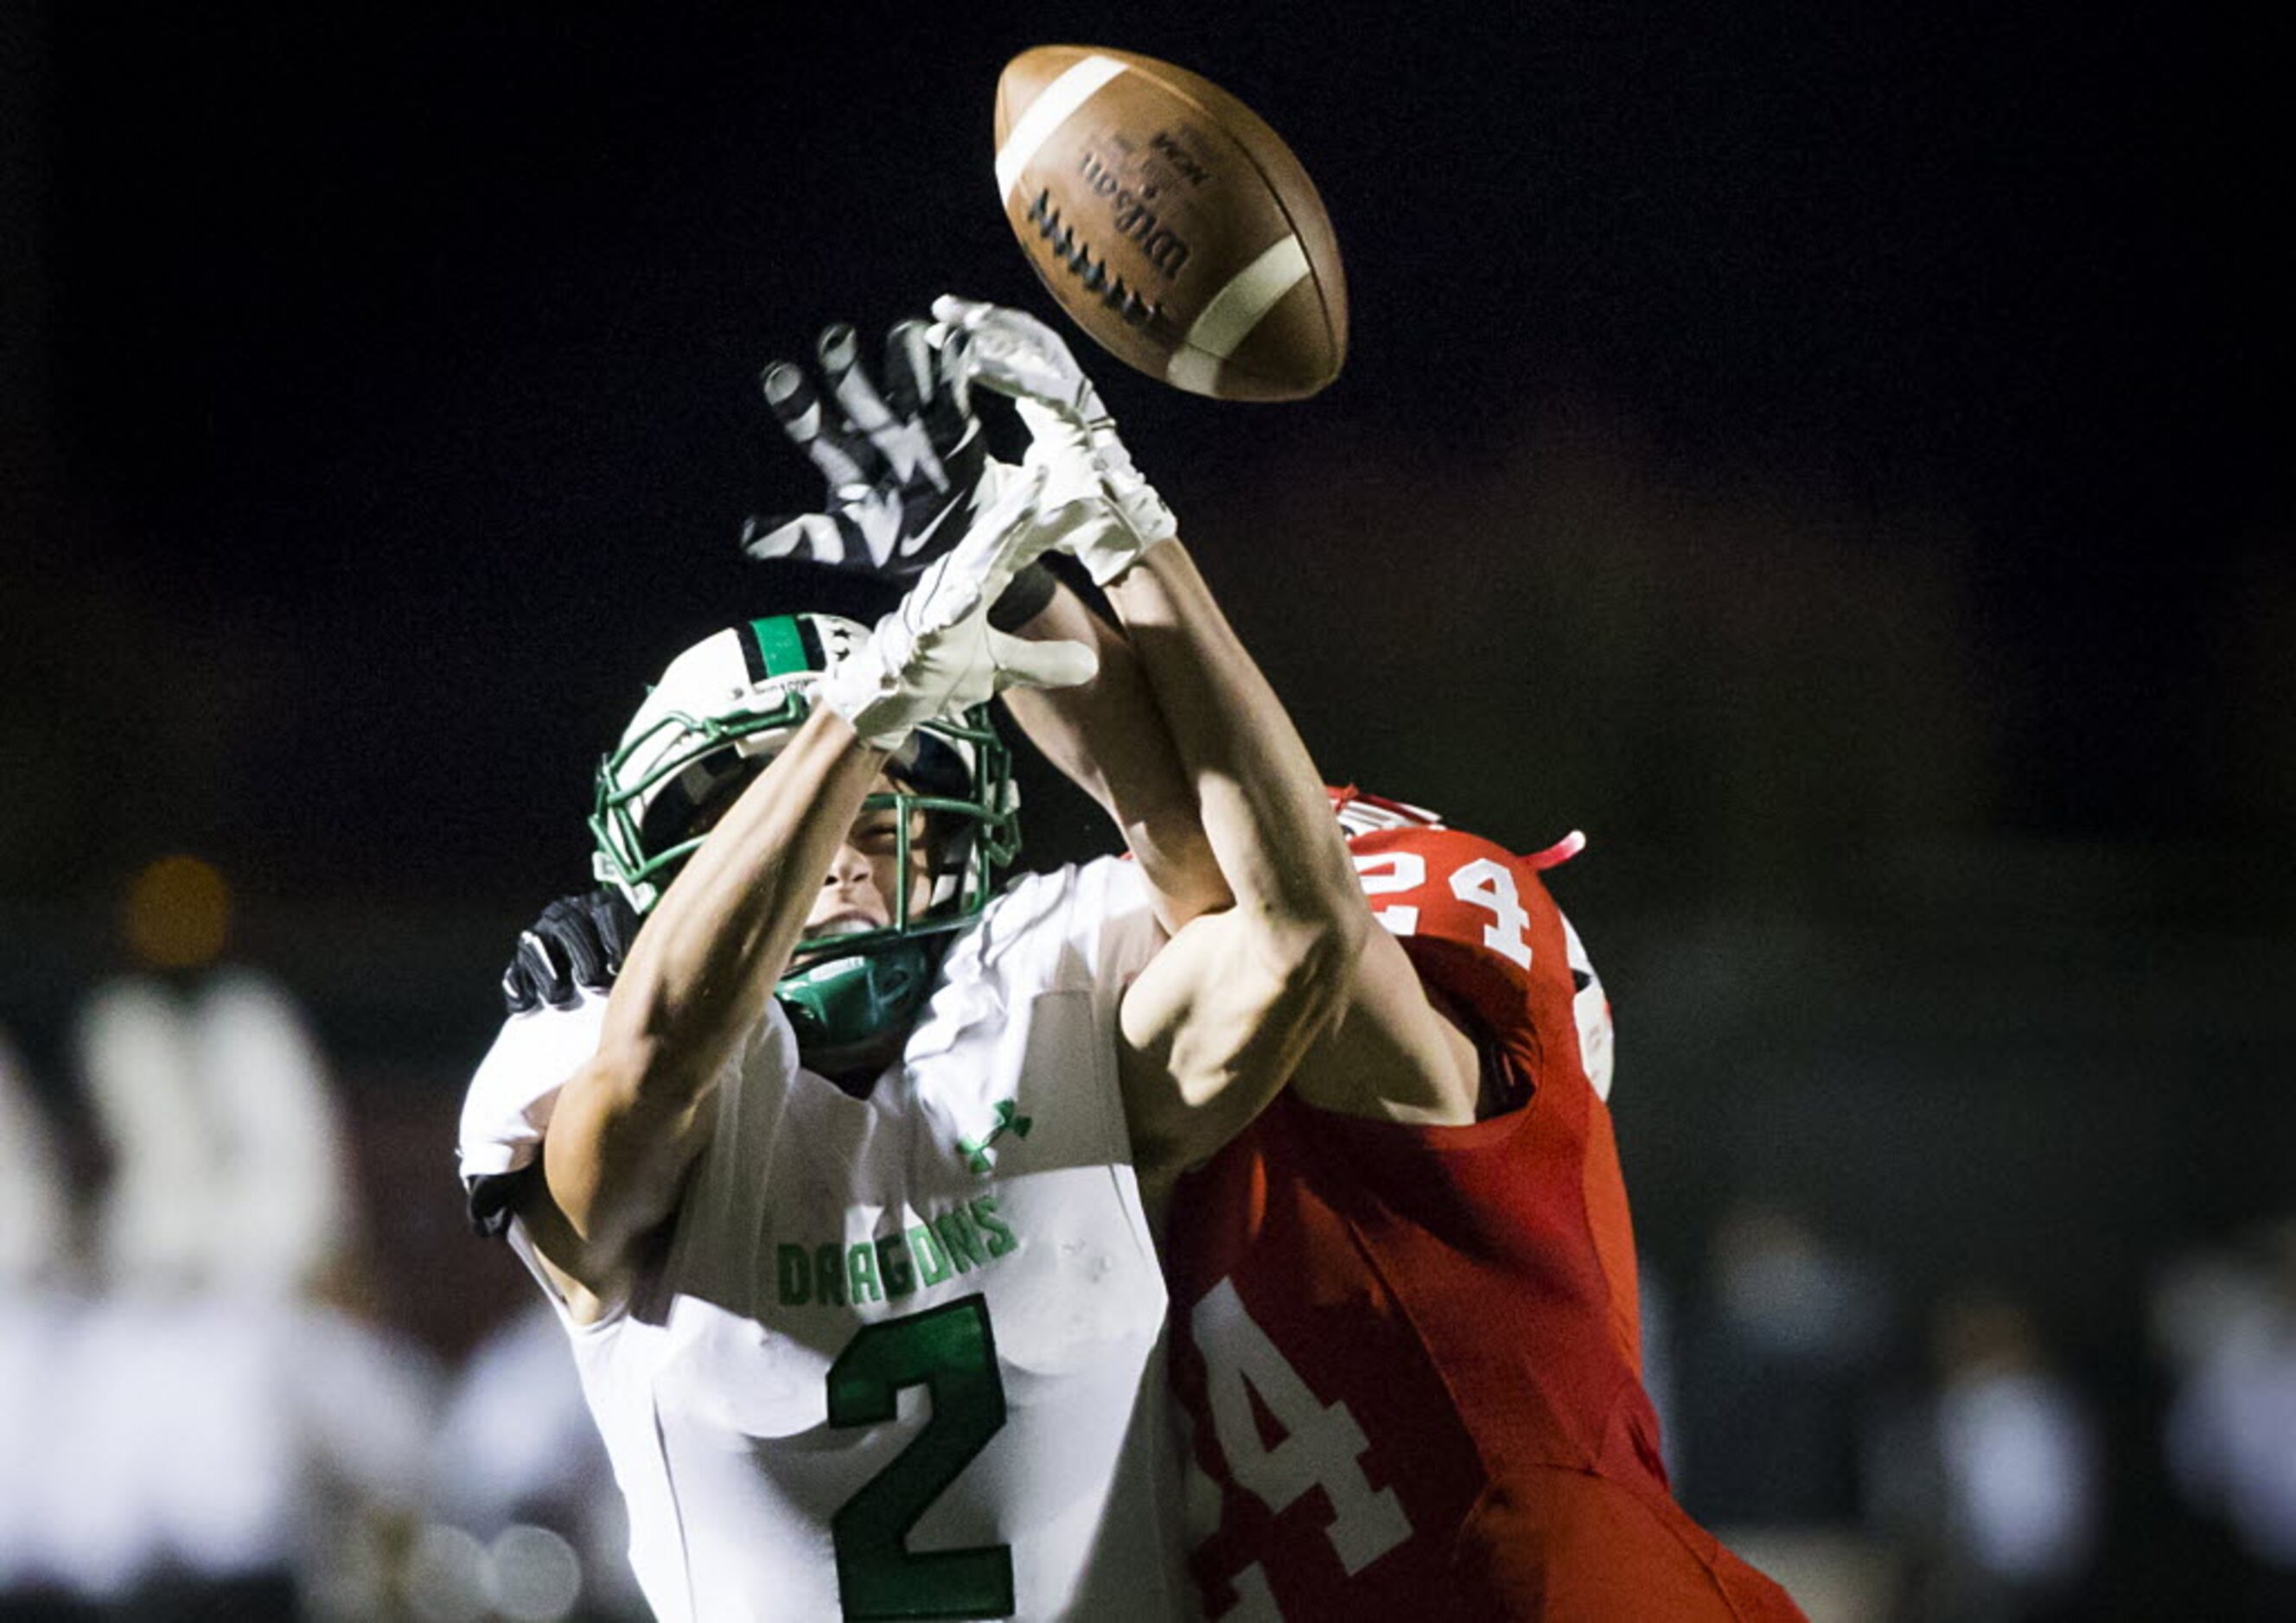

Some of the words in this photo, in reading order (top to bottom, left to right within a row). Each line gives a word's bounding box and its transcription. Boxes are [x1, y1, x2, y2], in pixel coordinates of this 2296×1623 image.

[1351, 851, 1533, 971] 24
[777, 1195, 1018, 1307] DRAGONS
[825, 1292, 1017, 1623] 2
